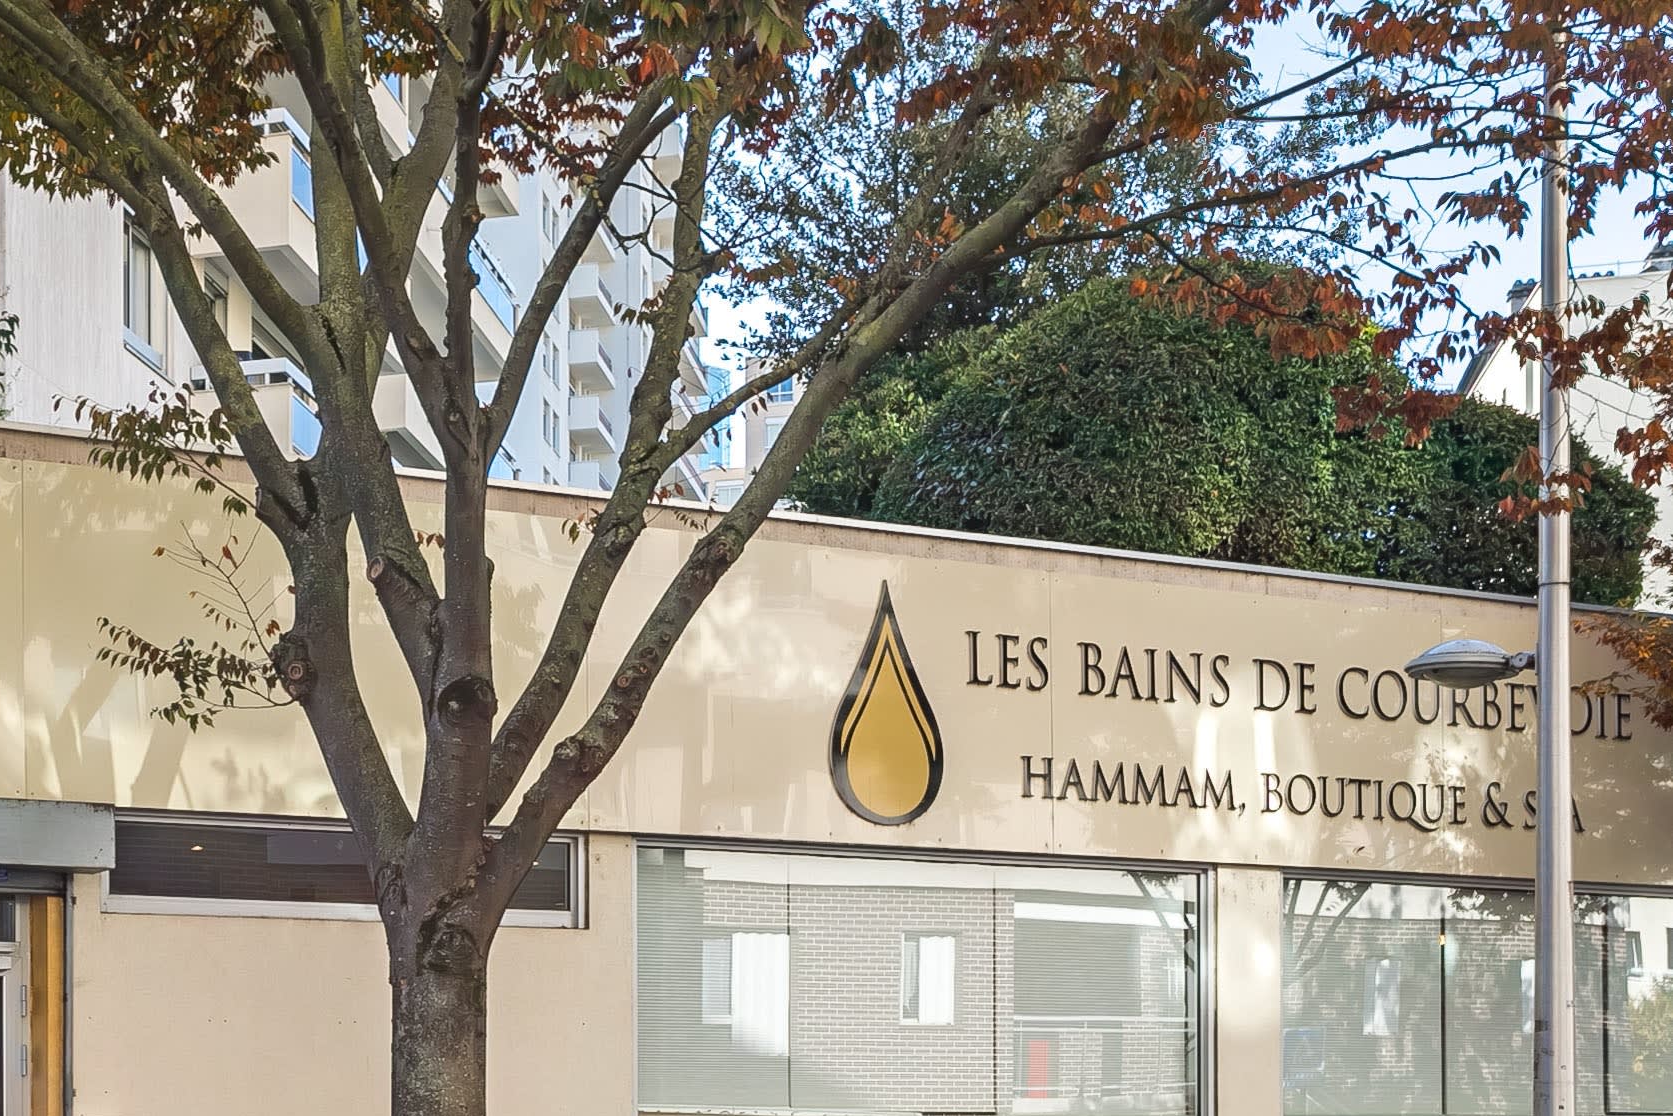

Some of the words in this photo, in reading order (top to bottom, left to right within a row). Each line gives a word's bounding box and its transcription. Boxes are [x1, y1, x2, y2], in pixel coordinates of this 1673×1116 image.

[965, 630, 1049, 692] LES
[1077, 641, 1231, 708] BAINS
[1252, 658, 1317, 715] DE
[1337, 666, 1633, 742] COURBEOIE
[1020, 755, 1246, 817] HAMMAM,
[1260, 772, 1468, 832] BOUTIQUE
[1480, 781, 1514, 830] &
